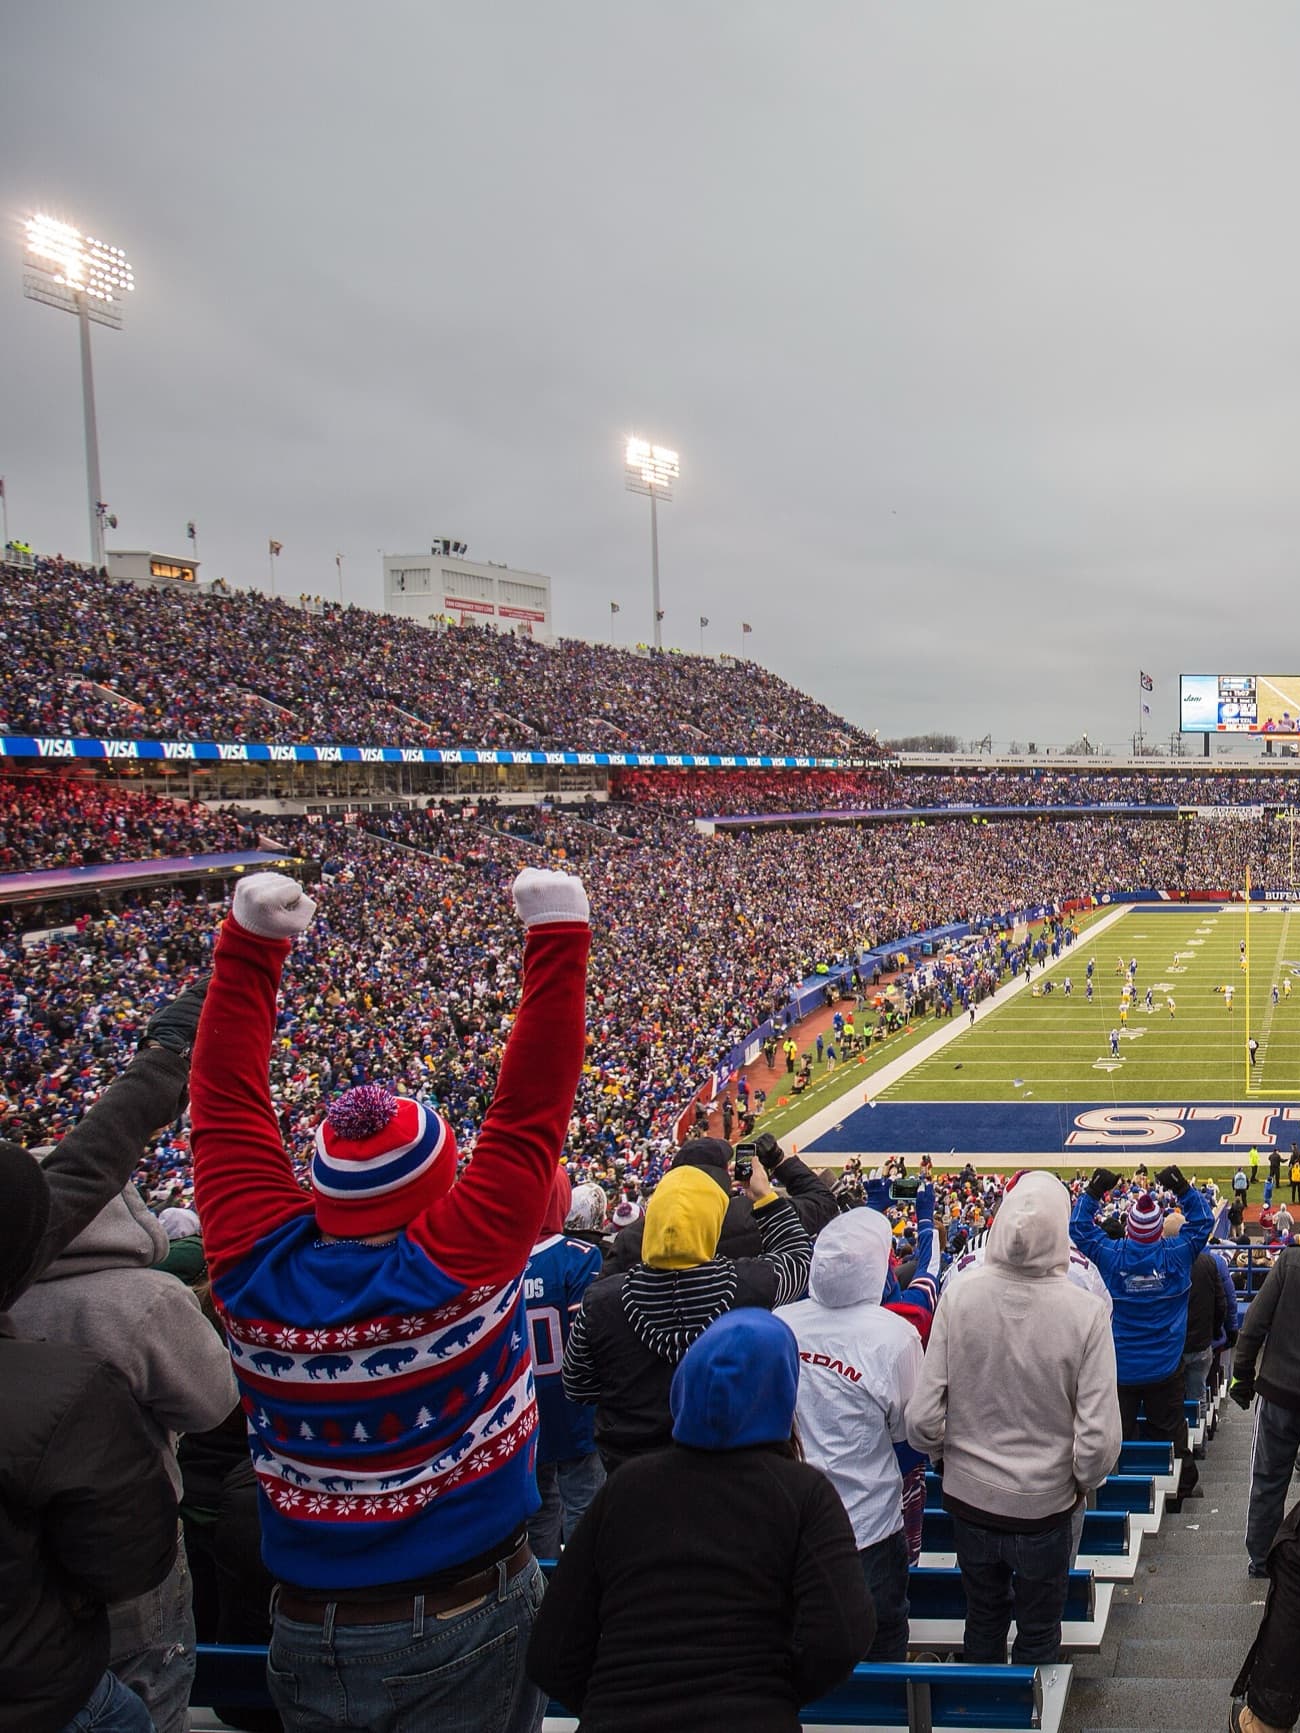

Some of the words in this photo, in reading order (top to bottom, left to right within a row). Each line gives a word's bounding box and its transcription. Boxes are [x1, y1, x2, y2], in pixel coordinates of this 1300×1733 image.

[35, 740, 74, 756] VISA
[101, 742, 138, 757] VISA
[161, 743, 195, 758] VISA
[216, 745, 248, 759] VISA
[268, 746, 297, 760] VISA
[315, 748, 342, 760] VISA
[358, 749, 384, 761] VISA
[400, 750, 425, 761] VISA
[439, 751, 462, 762] VISA
[476, 751, 498, 763] VISA
[511, 752, 532, 763] VISA
[544, 753, 566, 763] VISA
[577, 754, 596, 764] VISA
[607, 755, 627, 764] VISA
[637, 756, 655, 765] VISA
[665, 756, 683, 765] VISA
[692, 756, 710, 765] VISA
[719, 757, 736, 766] VISA
[745, 758, 762, 766] VISA
[770, 758, 786, 766] VISA
